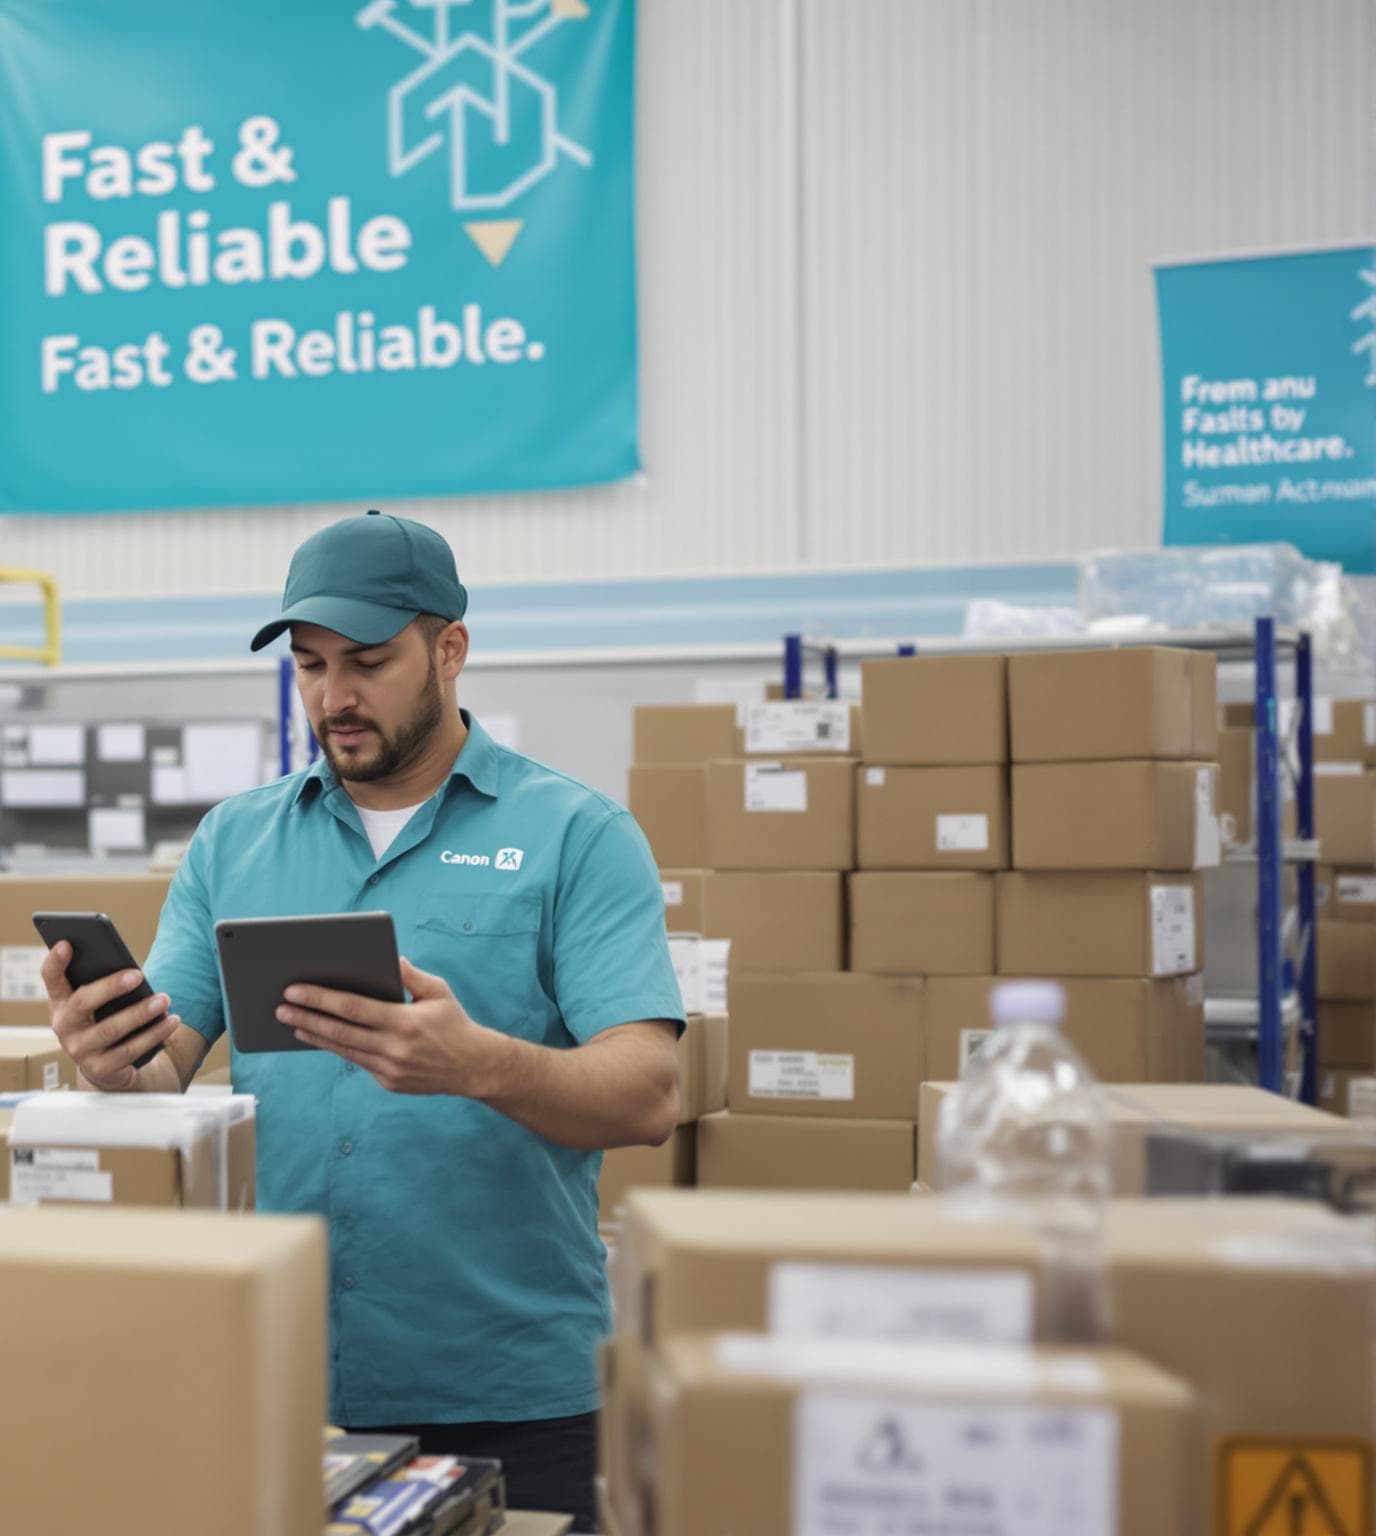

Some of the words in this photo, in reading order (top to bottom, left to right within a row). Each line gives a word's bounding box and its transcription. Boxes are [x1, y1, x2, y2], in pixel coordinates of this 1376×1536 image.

[42, 127, 215, 202] Fast
[232, 115, 296, 187] &
[44, 196, 411, 296] Reliable
[41, 333, 172, 392] Fast
[183, 324, 237, 383] &
[251, 304, 545, 379] Reliable.
[1270, 403, 1307, 432] by
[1182, 432, 1355, 468] Healthcare.
[440, 850, 490, 867] Canon
